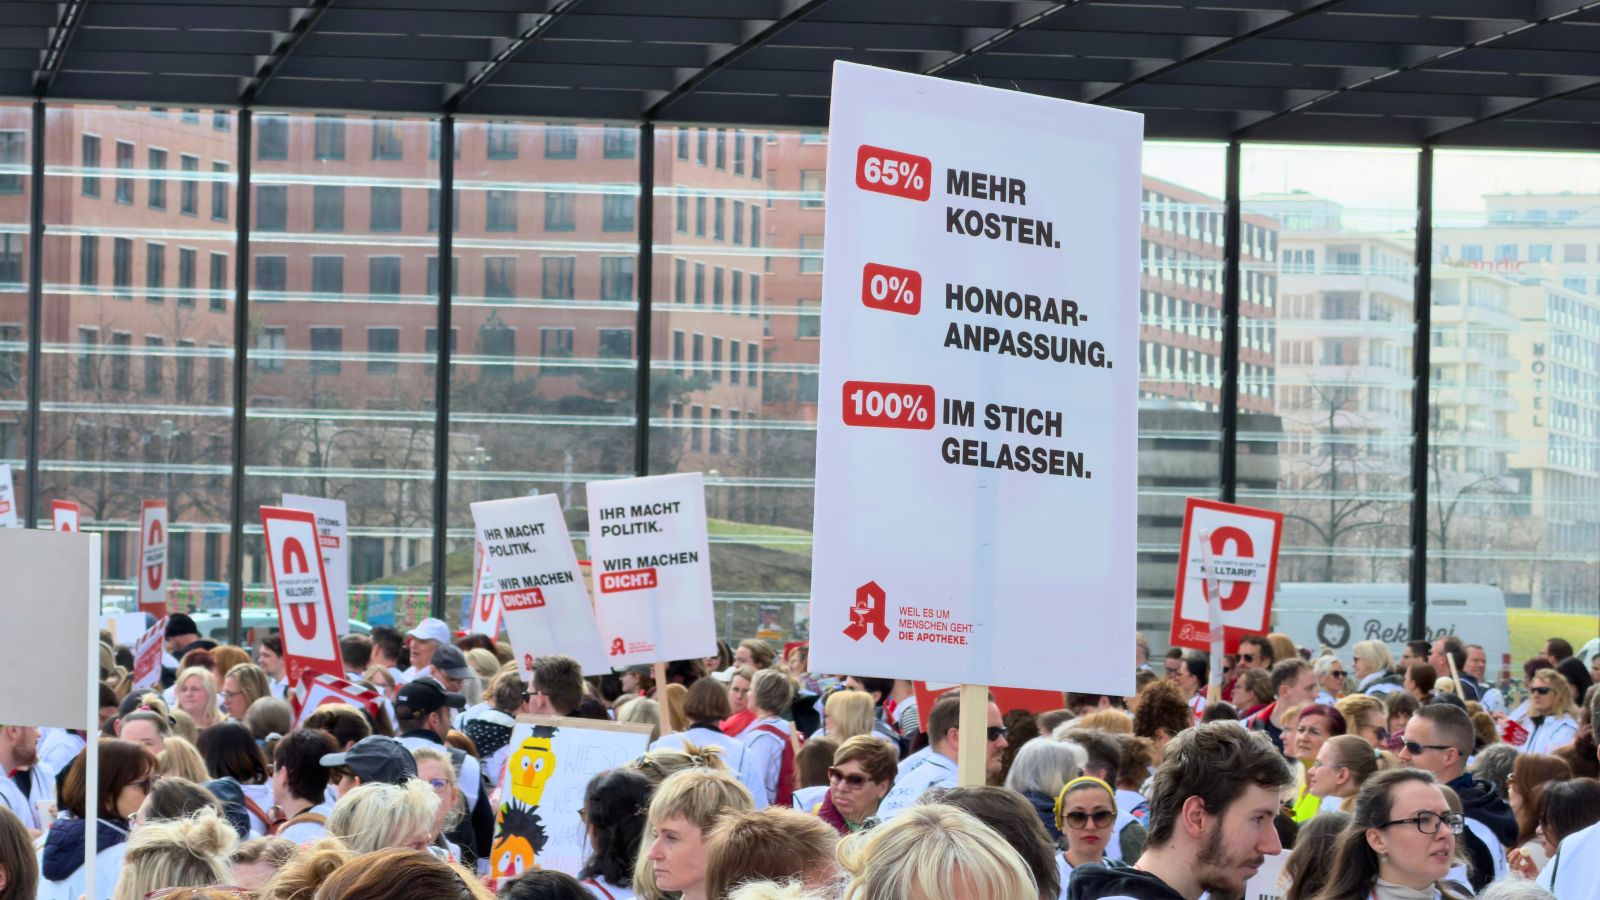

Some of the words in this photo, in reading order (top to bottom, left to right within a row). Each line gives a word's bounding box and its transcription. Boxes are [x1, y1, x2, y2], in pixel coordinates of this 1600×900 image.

[864, 157, 924, 190] 65%
[946, 168, 1026, 206] MEHR
[946, 206, 1060, 249] KOSTEN.
[870, 274, 914, 305] 0%
[945, 283, 1088, 327] HONORAR-
[943, 322, 1113, 369] ANPASSUNG.
[850, 389, 928, 422] 100%
[942, 398, 975, 428] IM
[984, 404, 1063, 438] STICH
[941, 437, 1092, 479] GELASSEN.
[600, 507, 625, 521] IHR
[630, 501, 681, 518] MACHT
[483, 528, 503, 541] IHR
[504, 523, 546, 539] MACHT
[601, 520, 663, 538] POLITIK.
[488, 542, 537, 557] POLITIK.
[603, 557, 632, 572] WIR
[637, 551, 699, 569] MACHEN
[497, 576, 520, 590] WIR
[521, 571, 574, 588] MACHEN
[604, 572, 654, 590] DICHT.
[502, 592, 542, 607] DICHT.
[899, 606, 921, 617] WEIL
[922, 608, 934, 618] ES
[936, 609, 950, 619] UM
[898, 618, 948, 632] MENSCHEN
[950, 624, 975, 634] GEHT.
[898, 631, 914, 641] DIE
[916, 632, 968, 645] APOTHEKE.
